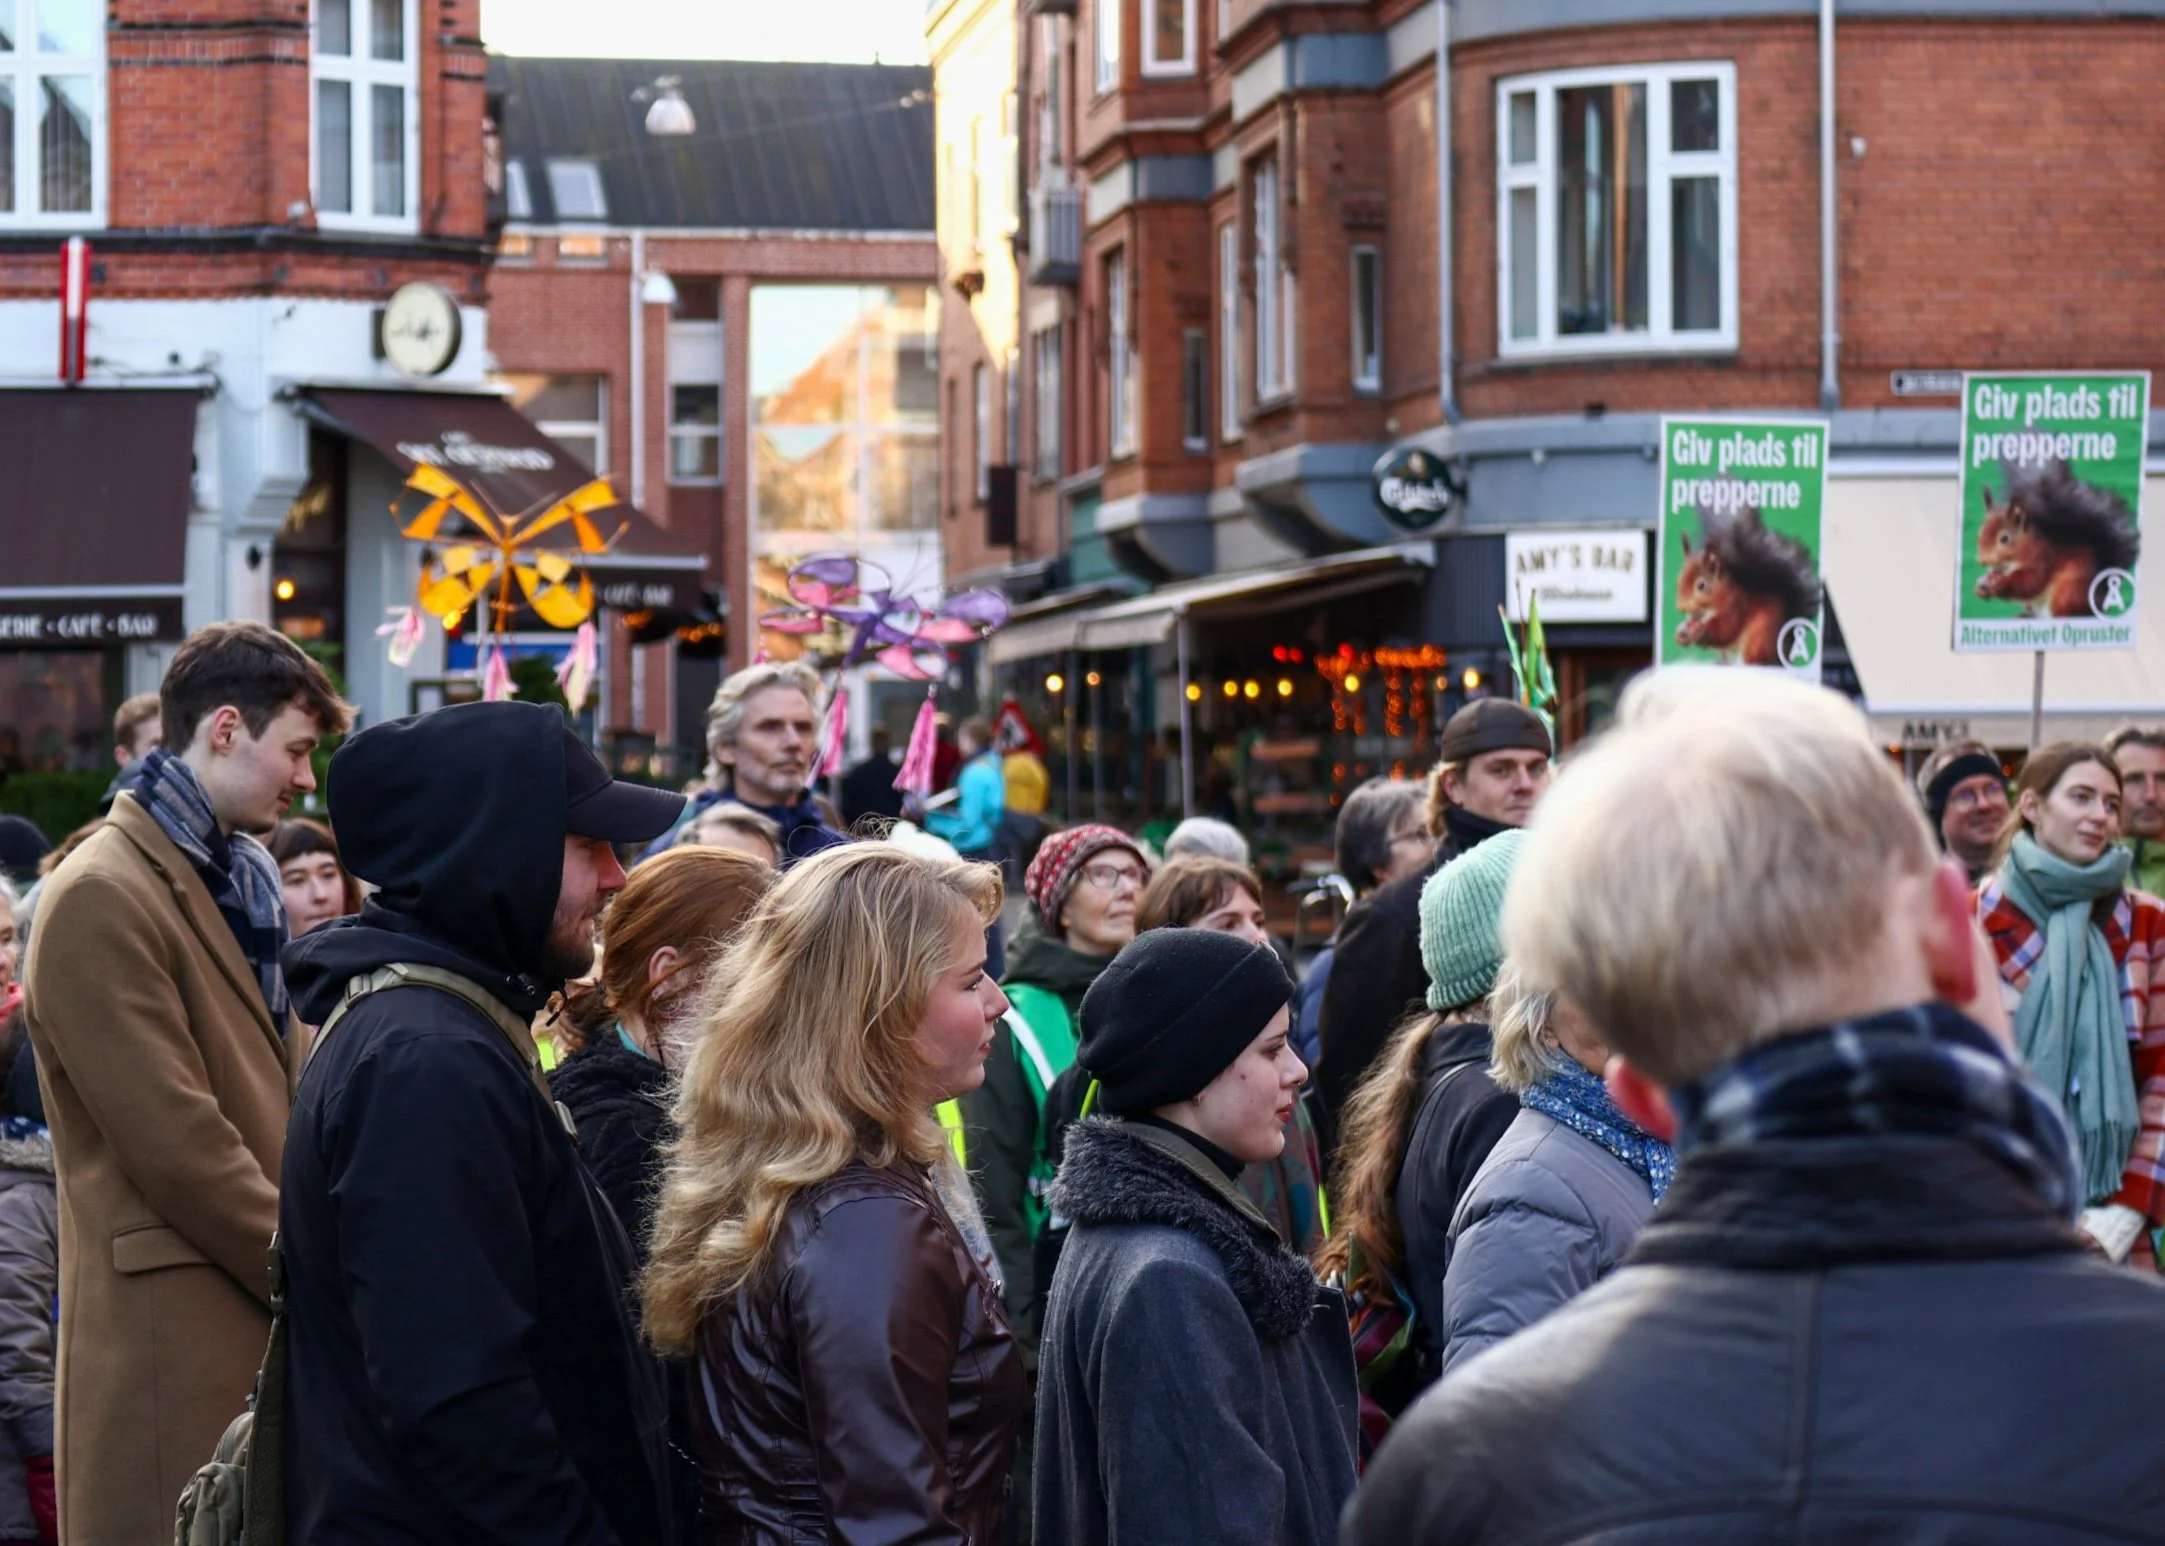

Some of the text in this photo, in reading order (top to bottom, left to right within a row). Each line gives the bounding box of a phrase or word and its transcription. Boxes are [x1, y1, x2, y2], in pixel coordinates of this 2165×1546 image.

[1974, 383, 2018, 419] Giv
[2025, 384, 2101, 427] plads
[2108, 384, 2138, 419] til
[1672, 429, 1818, 473] Giv plads til
[1972, 431, 2117, 468] prepperne
[1671, 478, 1801, 515] prepperne
[1516, 544, 1582, 574] AMY'S
[57, 611, 104, 638] CAFÉ
[117, 613, 158, 637] BAR
[1961, 623, 2130, 646] Alternativet Opruster
